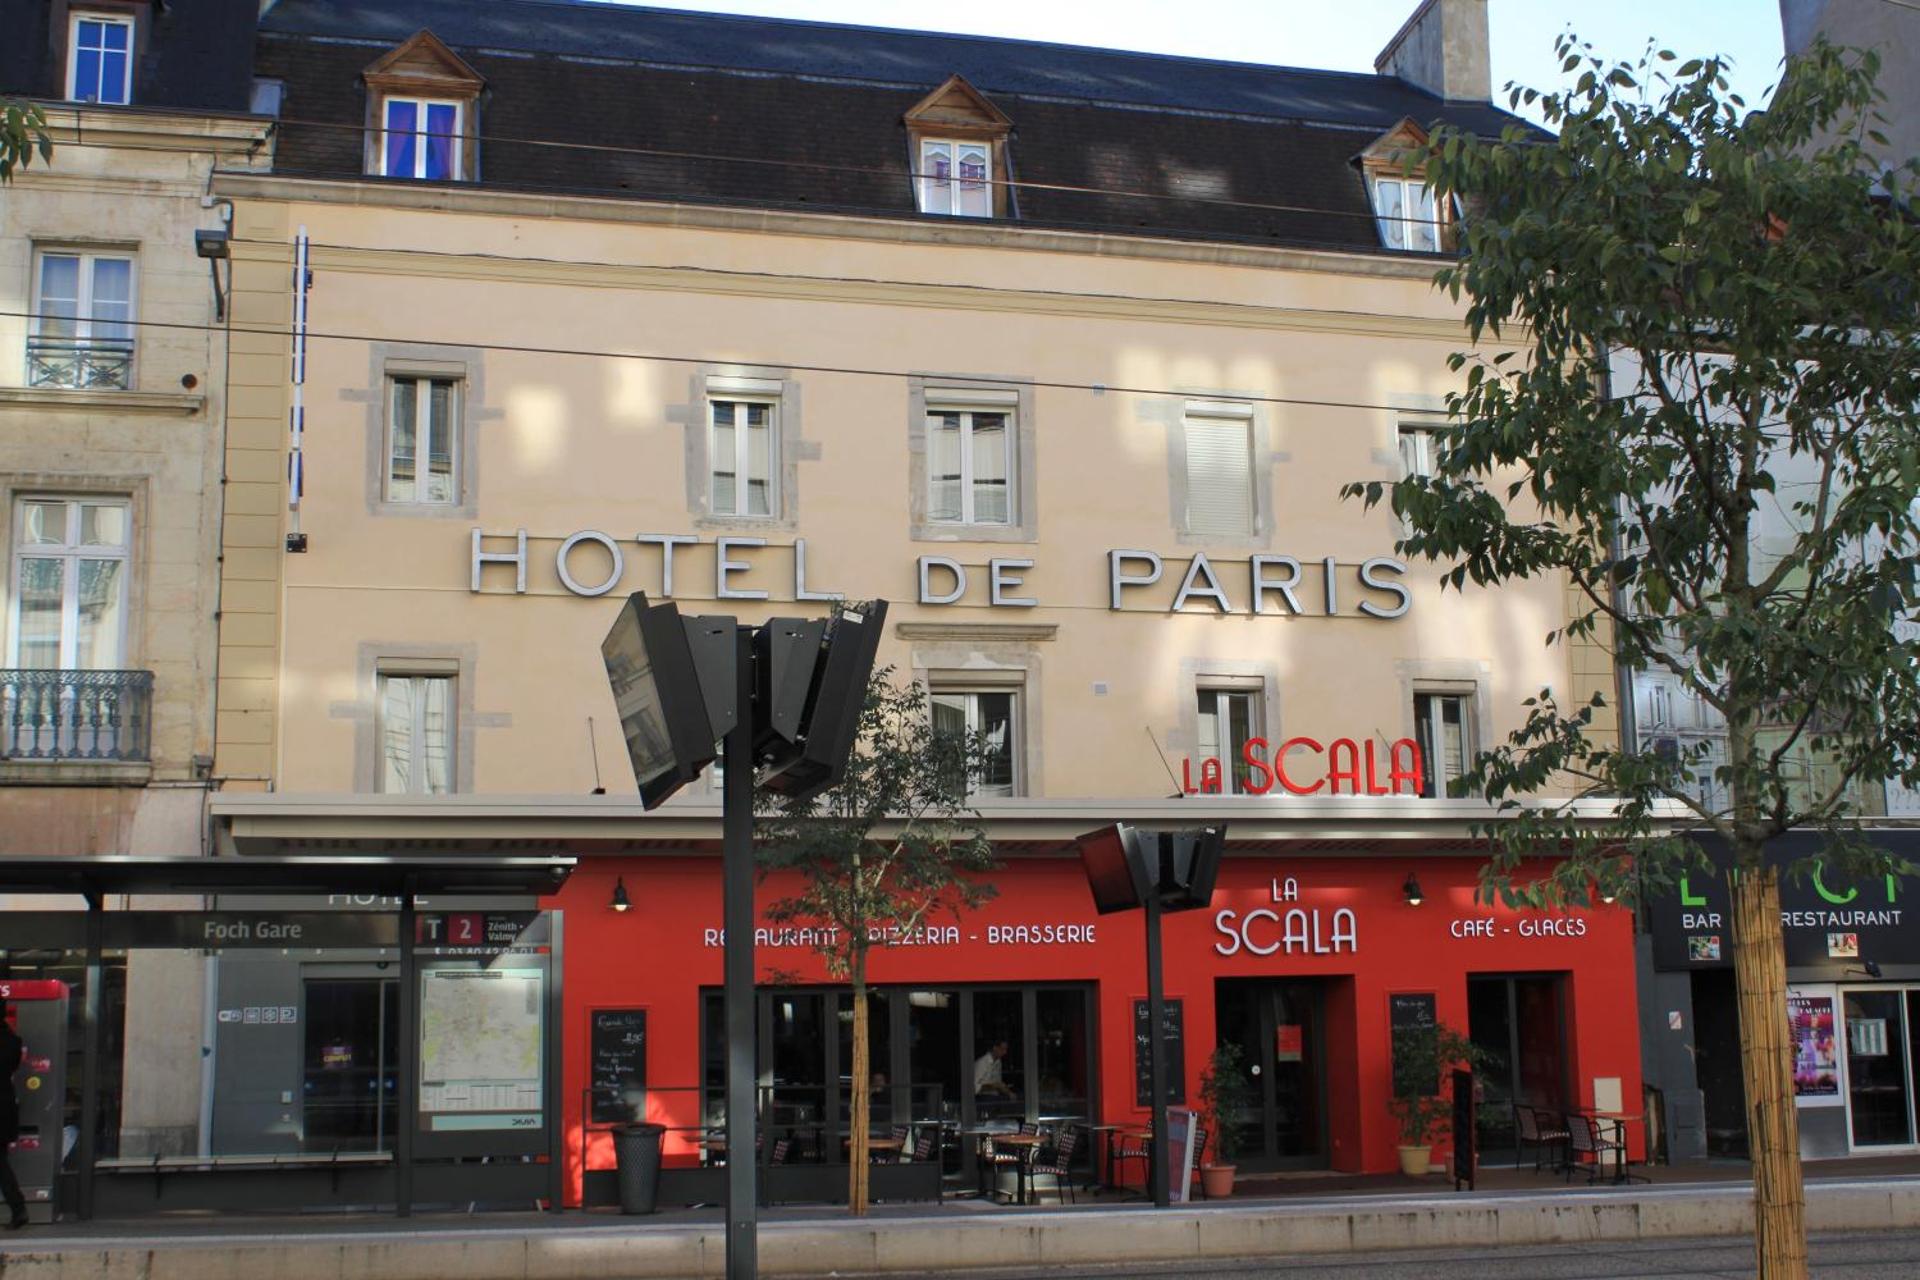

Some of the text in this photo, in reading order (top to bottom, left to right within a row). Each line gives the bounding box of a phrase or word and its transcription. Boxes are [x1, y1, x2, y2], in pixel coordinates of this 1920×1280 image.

[470, 527, 1413, 620] HOTEL DE PARIS
[1182, 737, 1424, 795] LA SCALA
[1272, 878, 1298, 901] LA
[204, 920, 302, 938] Foch Gare
[427, 919, 472, 939] T 2
[1451, 917, 1495, 937] CAFÉ
[1519, 918, 1586, 937] GLACES
[1682, 910, 1902, 929] BAR RESTAURANT
[704, 927, 839, 947] REAURANT
[988, 925, 1096, 944] BRASSERIE
[1215, 908, 1357, 955] SCALA
